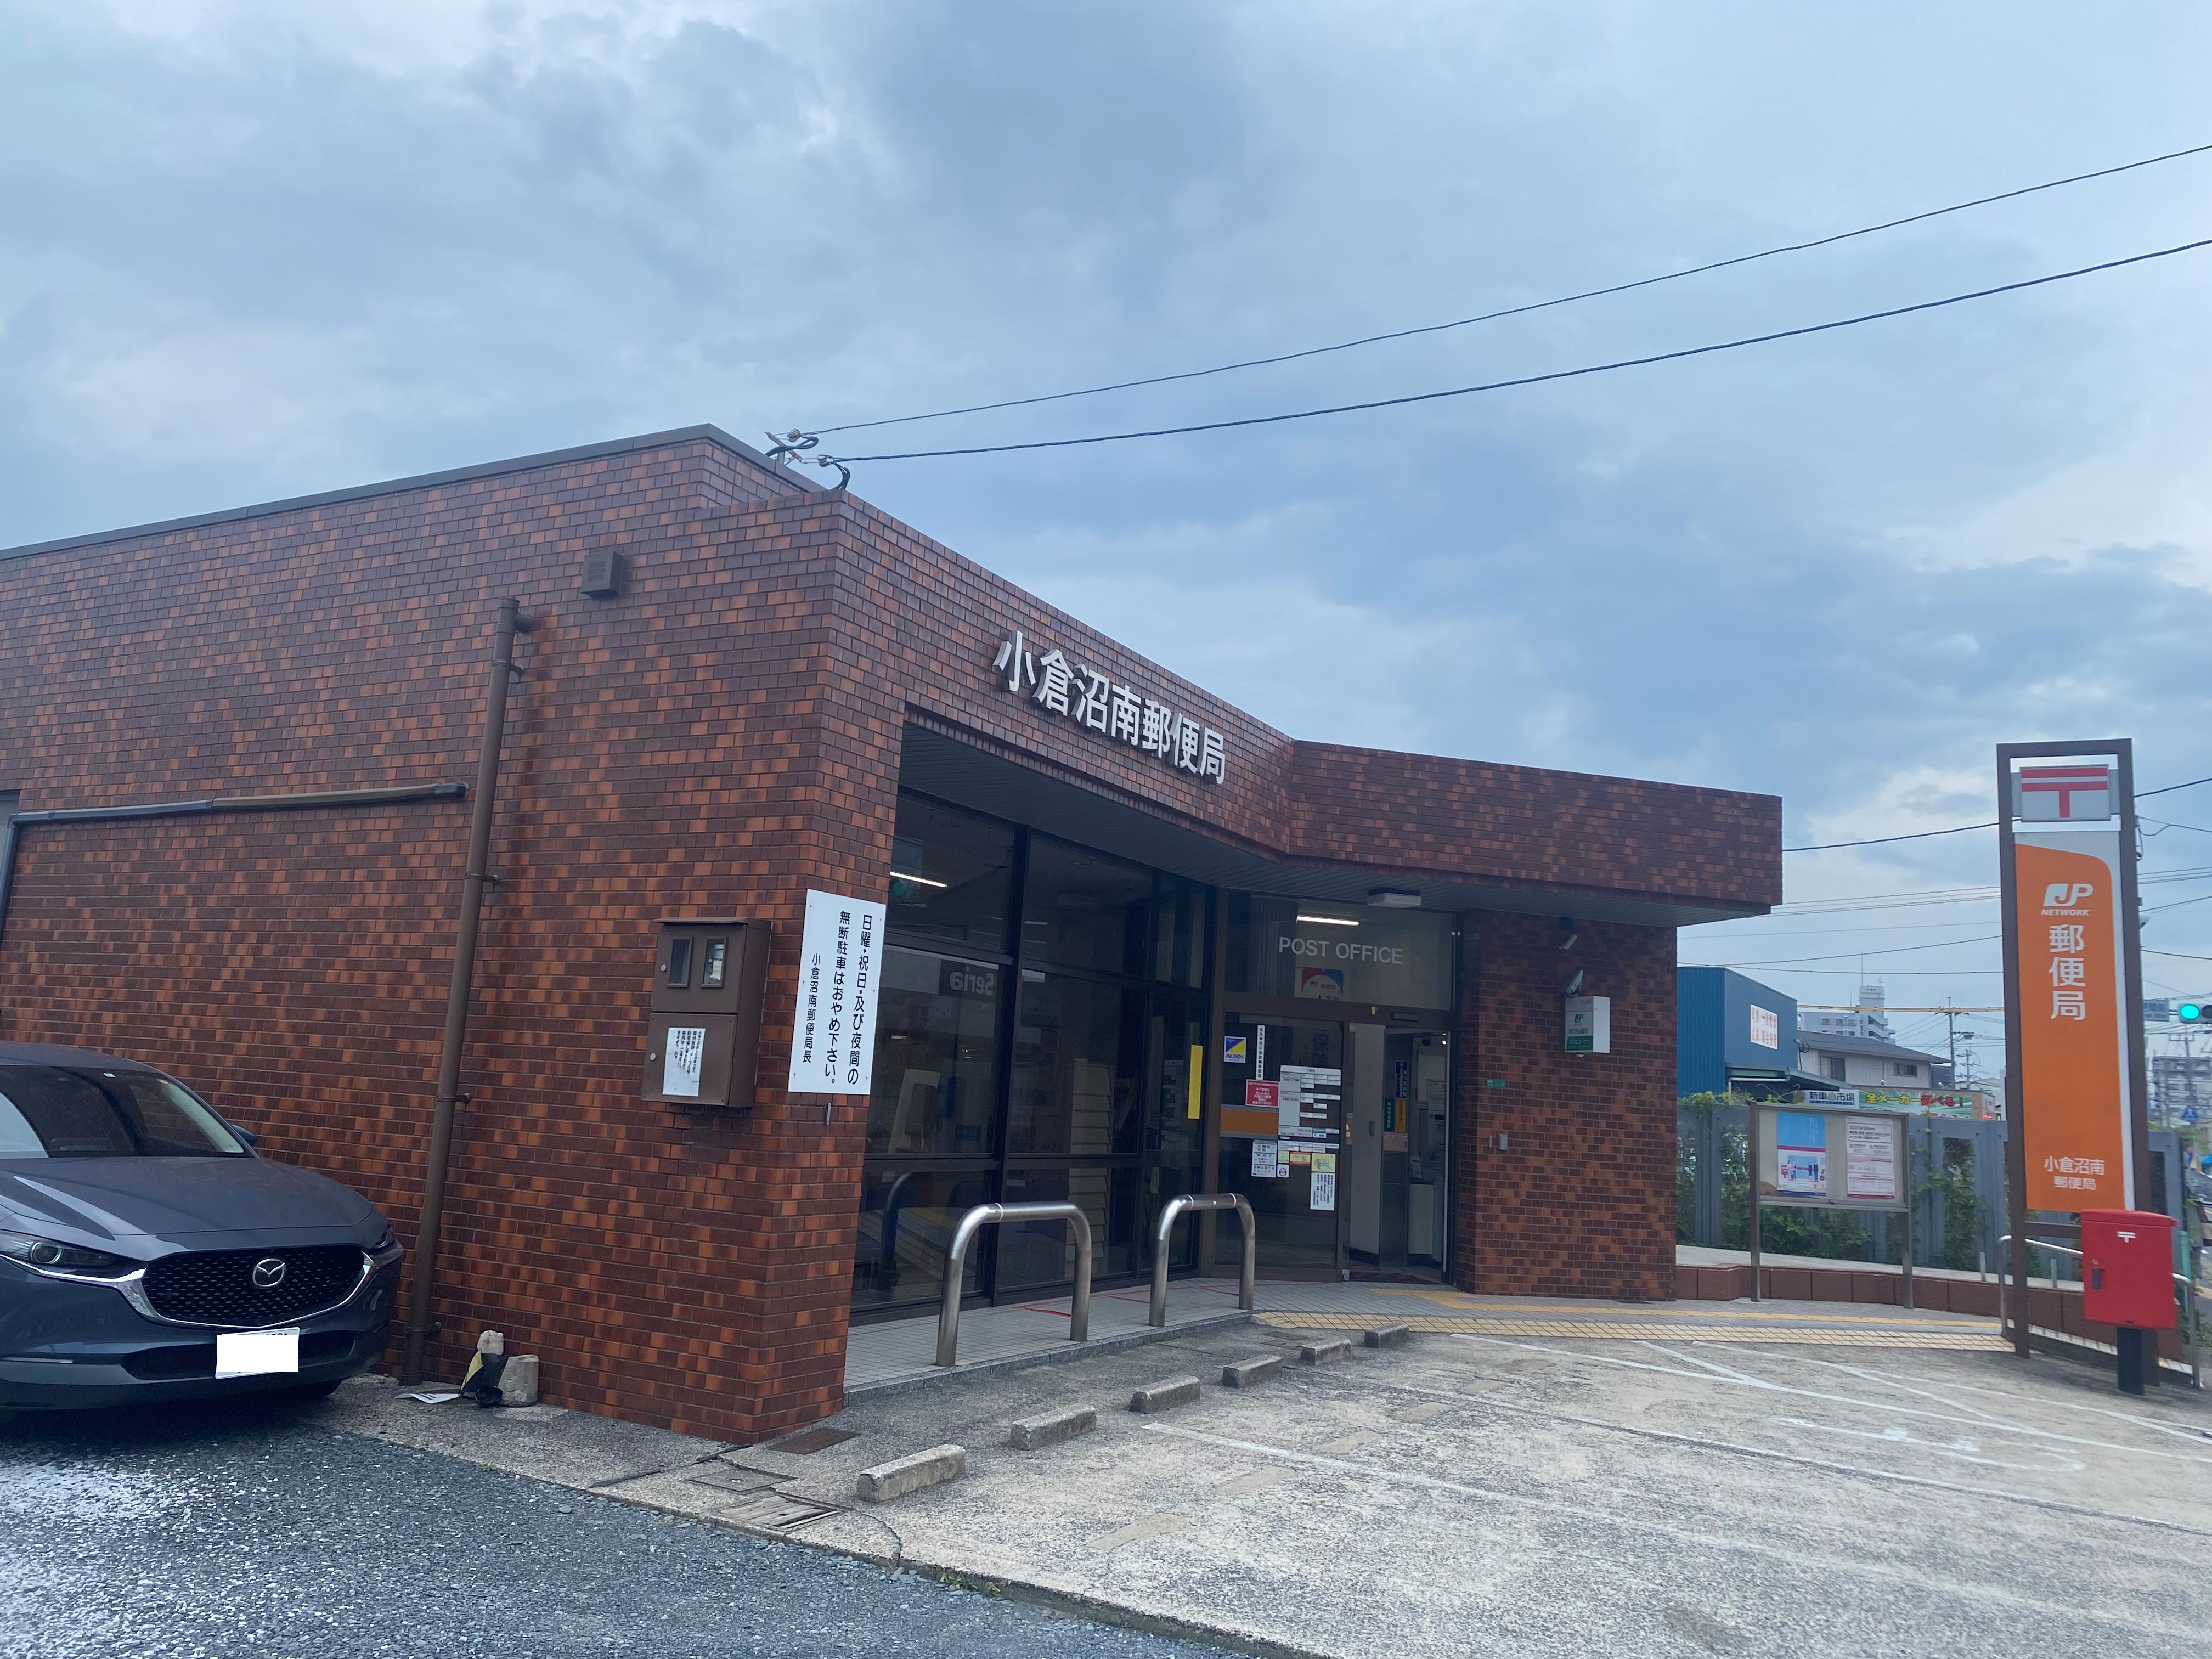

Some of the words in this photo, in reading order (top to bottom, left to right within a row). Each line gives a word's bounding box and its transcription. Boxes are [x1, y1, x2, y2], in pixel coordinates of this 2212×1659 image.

[992, 630, 1226, 785] 小倉沼南郵便局
[2044, 883, 2094, 906] JP
[825, 910, 851, 1084] 無断駐車はおやめ下さい。
[1279, 936, 1330, 957] POST
[1335, 943, 1403, 964] OFFICE
[2049, 923, 2086, 1021] 郵便局
[803, 952, 821, 1063] 小倉沼南郵便局長
[847, 914, 873, 1085] 日曜・祝日・及び夜間の
[2043, 1155, 2106, 1176] 小倉沼南
[2053, 1176, 2097, 1190] 郵便局
